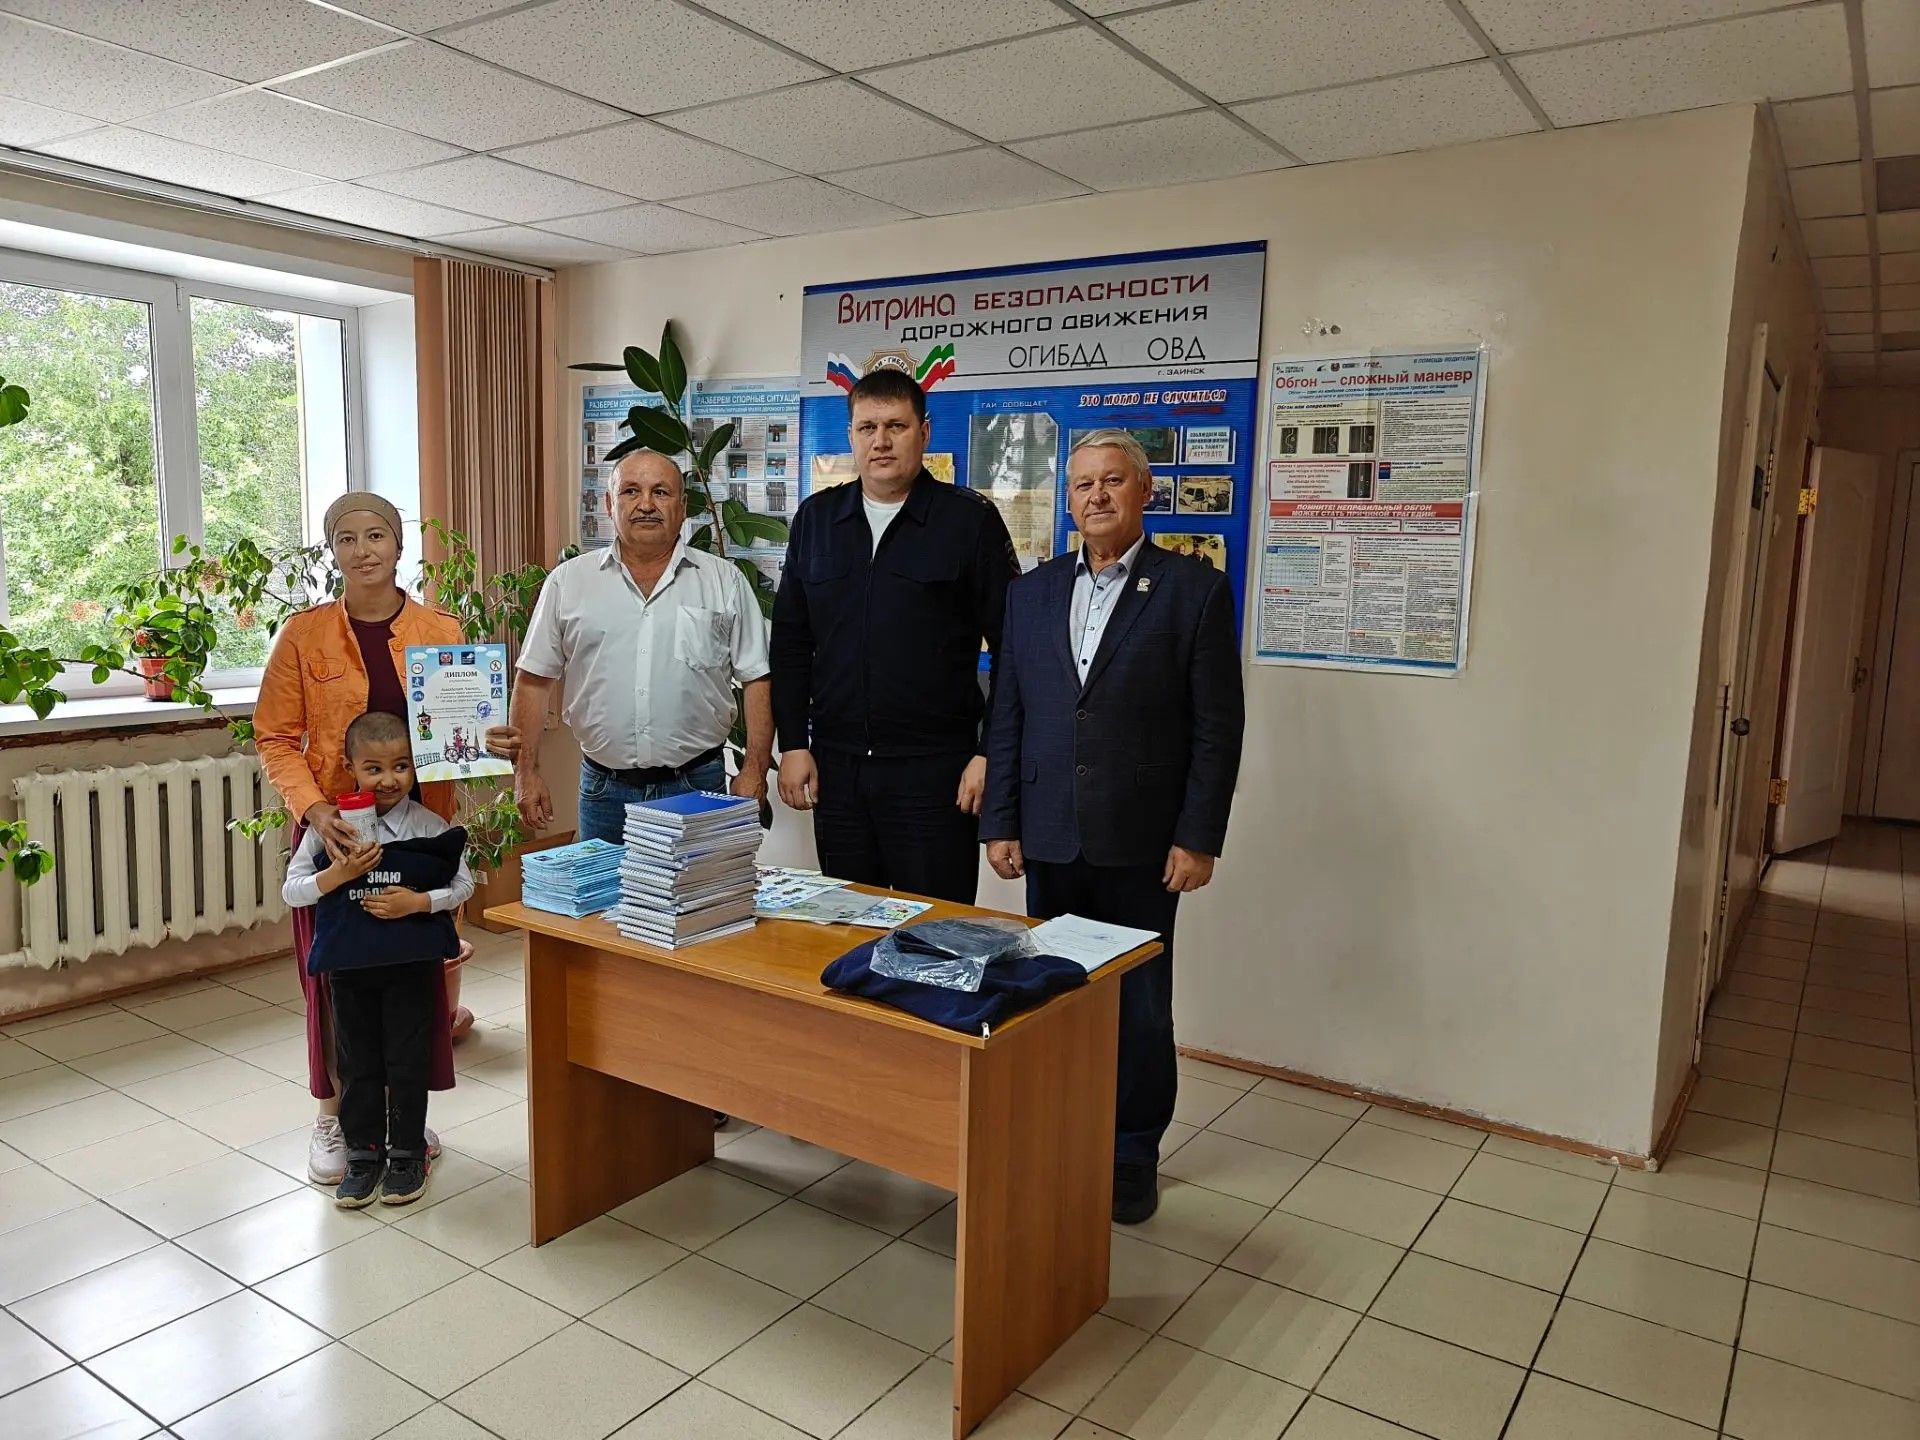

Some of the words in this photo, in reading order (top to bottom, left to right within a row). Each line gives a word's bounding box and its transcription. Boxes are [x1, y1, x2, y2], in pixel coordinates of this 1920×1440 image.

[838, 292, 955, 330] Витрина
[974, 273, 1210, 311] БЕЗОПАСНОСТИ
[901, 316, 1052, 344] ДОРОЖНОГО
[1061, 305, 1208, 330] ДВИЖЕНИЯ
[1008, 342, 1107, 369] ОГИБДД
[1147, 336, 1206, 361] ОВД
[1167, 367, 1206, 376] ЗАИНСК
[1275, 376, 1318, 389] Обгон
[1340, 369, 1409, 387] сложный
[1413, 370, 1473, 384] маневр
[588, 400, 619, 409] РАЗБЕРЕМ
[731, 394, 765, 404] СПОРНЫЕ
[1002, 400, 1048, 408] СООБЩАЕТ
[1079, 394, 1100, 407] ЭТО
[1103, 393, 1140, 406] МОГЛО
[1144, 392, 1159, 405] НЕ
[1162, 389, 1227, 405] СЛУЧИТЬСЯ
[444, 671, 478, 679] ДИПЛОМ
[367, 871, 401, 884] ЗНАЮ
